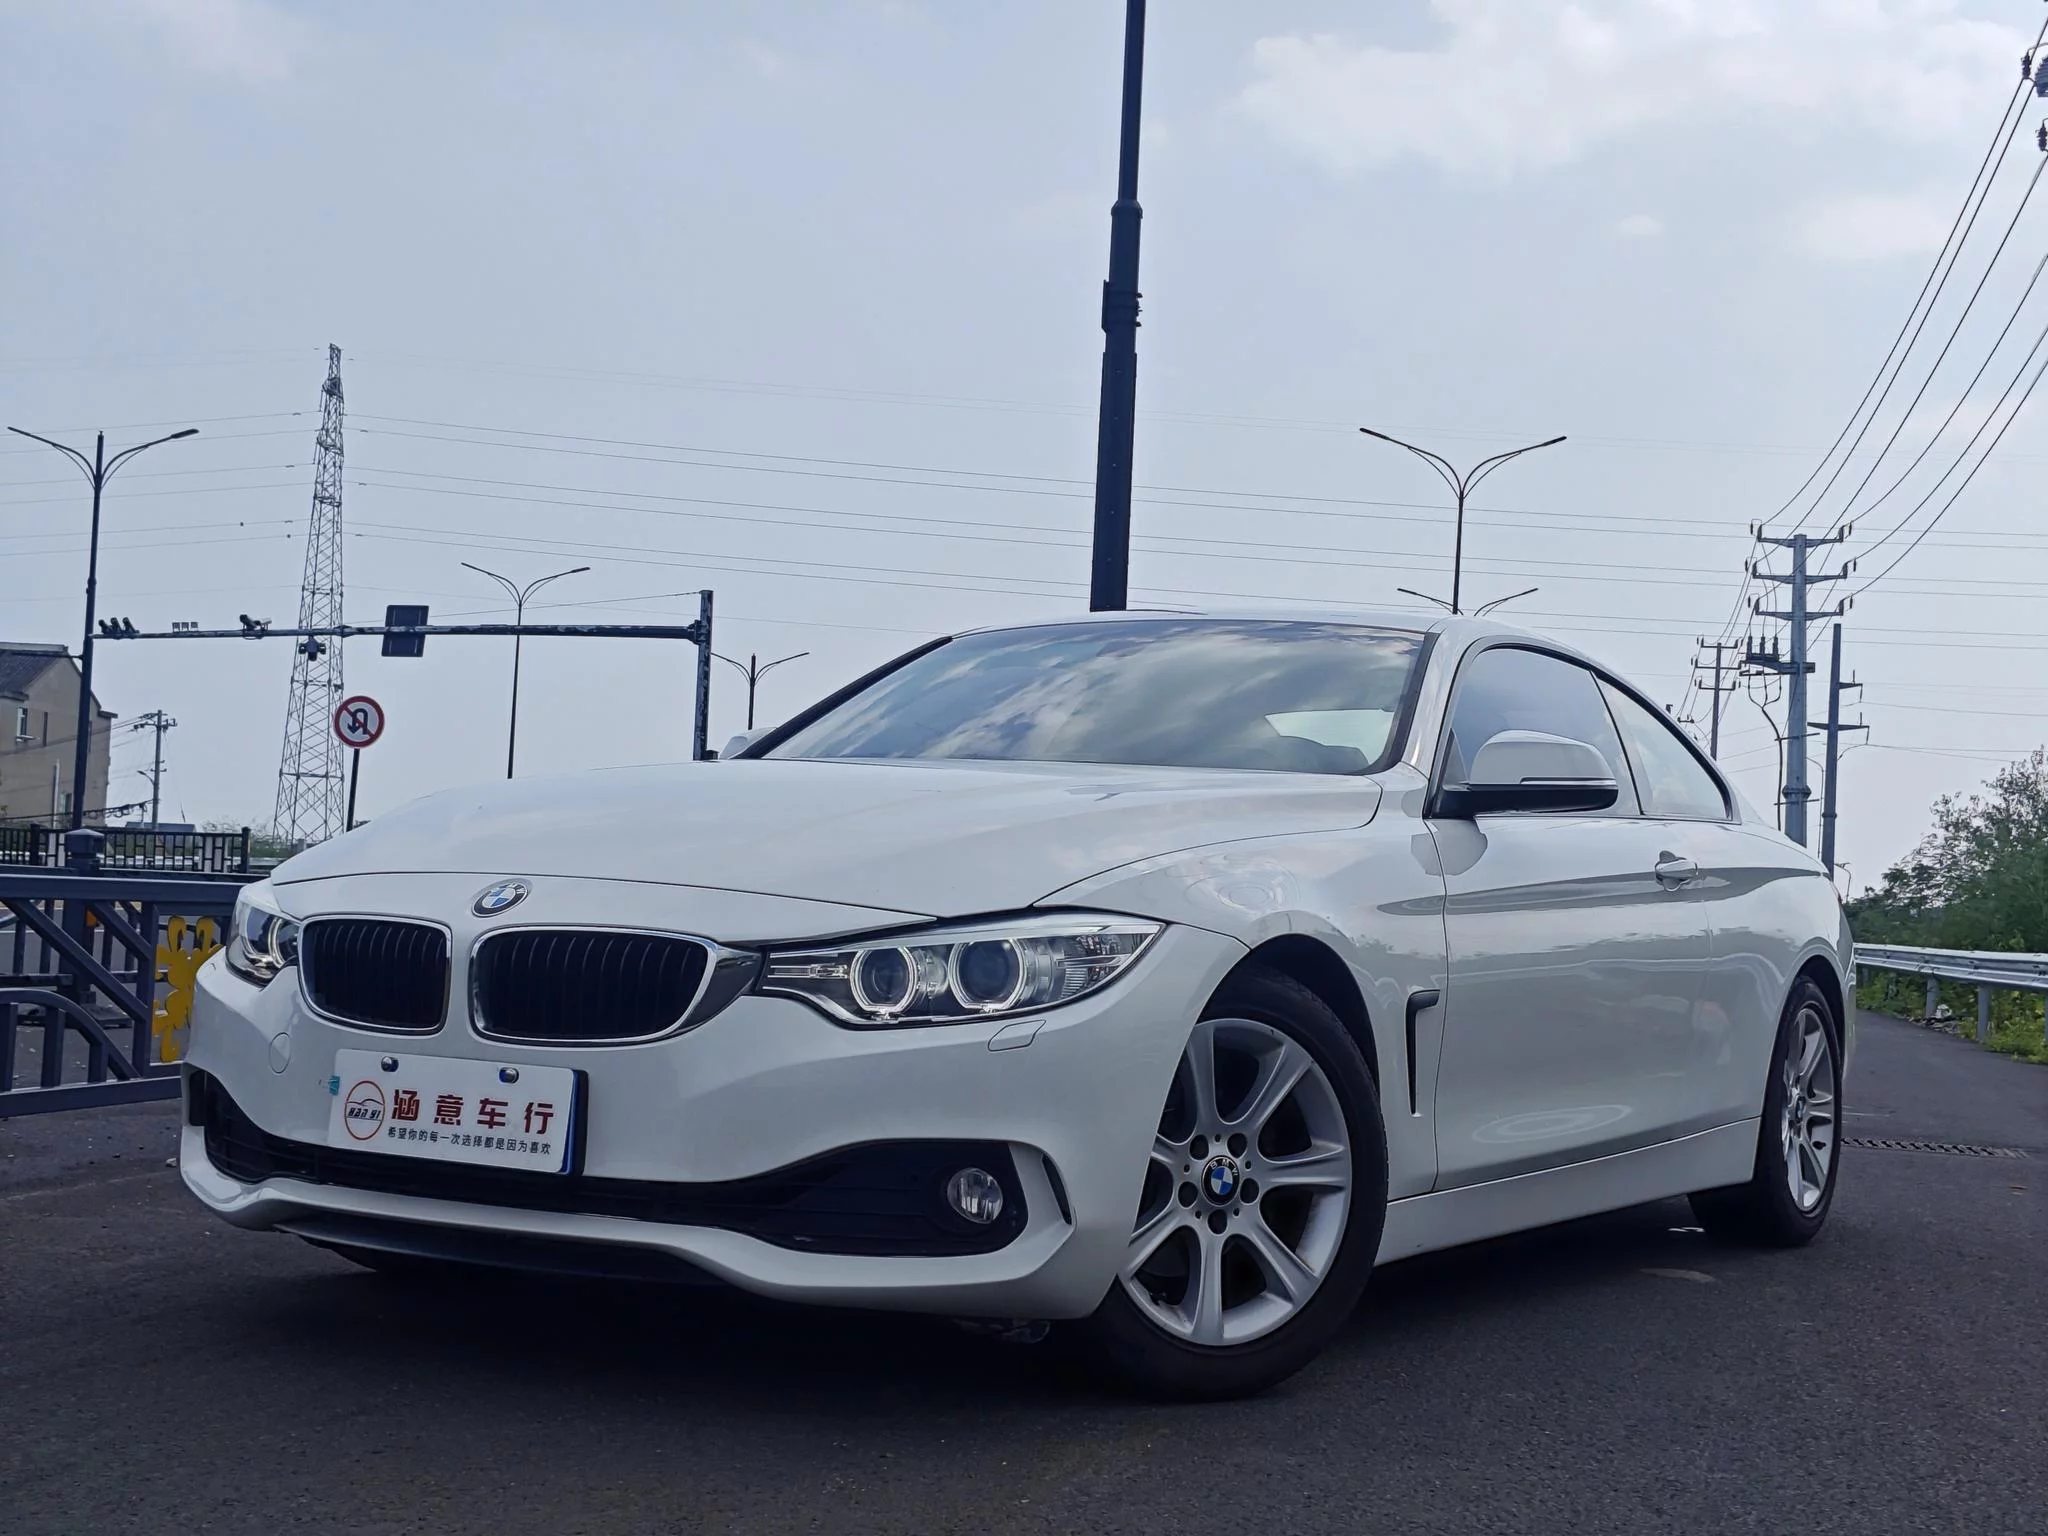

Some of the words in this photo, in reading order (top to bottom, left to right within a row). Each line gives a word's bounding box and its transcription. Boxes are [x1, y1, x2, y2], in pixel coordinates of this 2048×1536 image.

[391, 1088, 554, 1135] 涵意车行
[387, 1126, 551, 1155] 希望你的每一次选择都是因为喜欢
[1210, 1158, 1239, 1176] BMW
